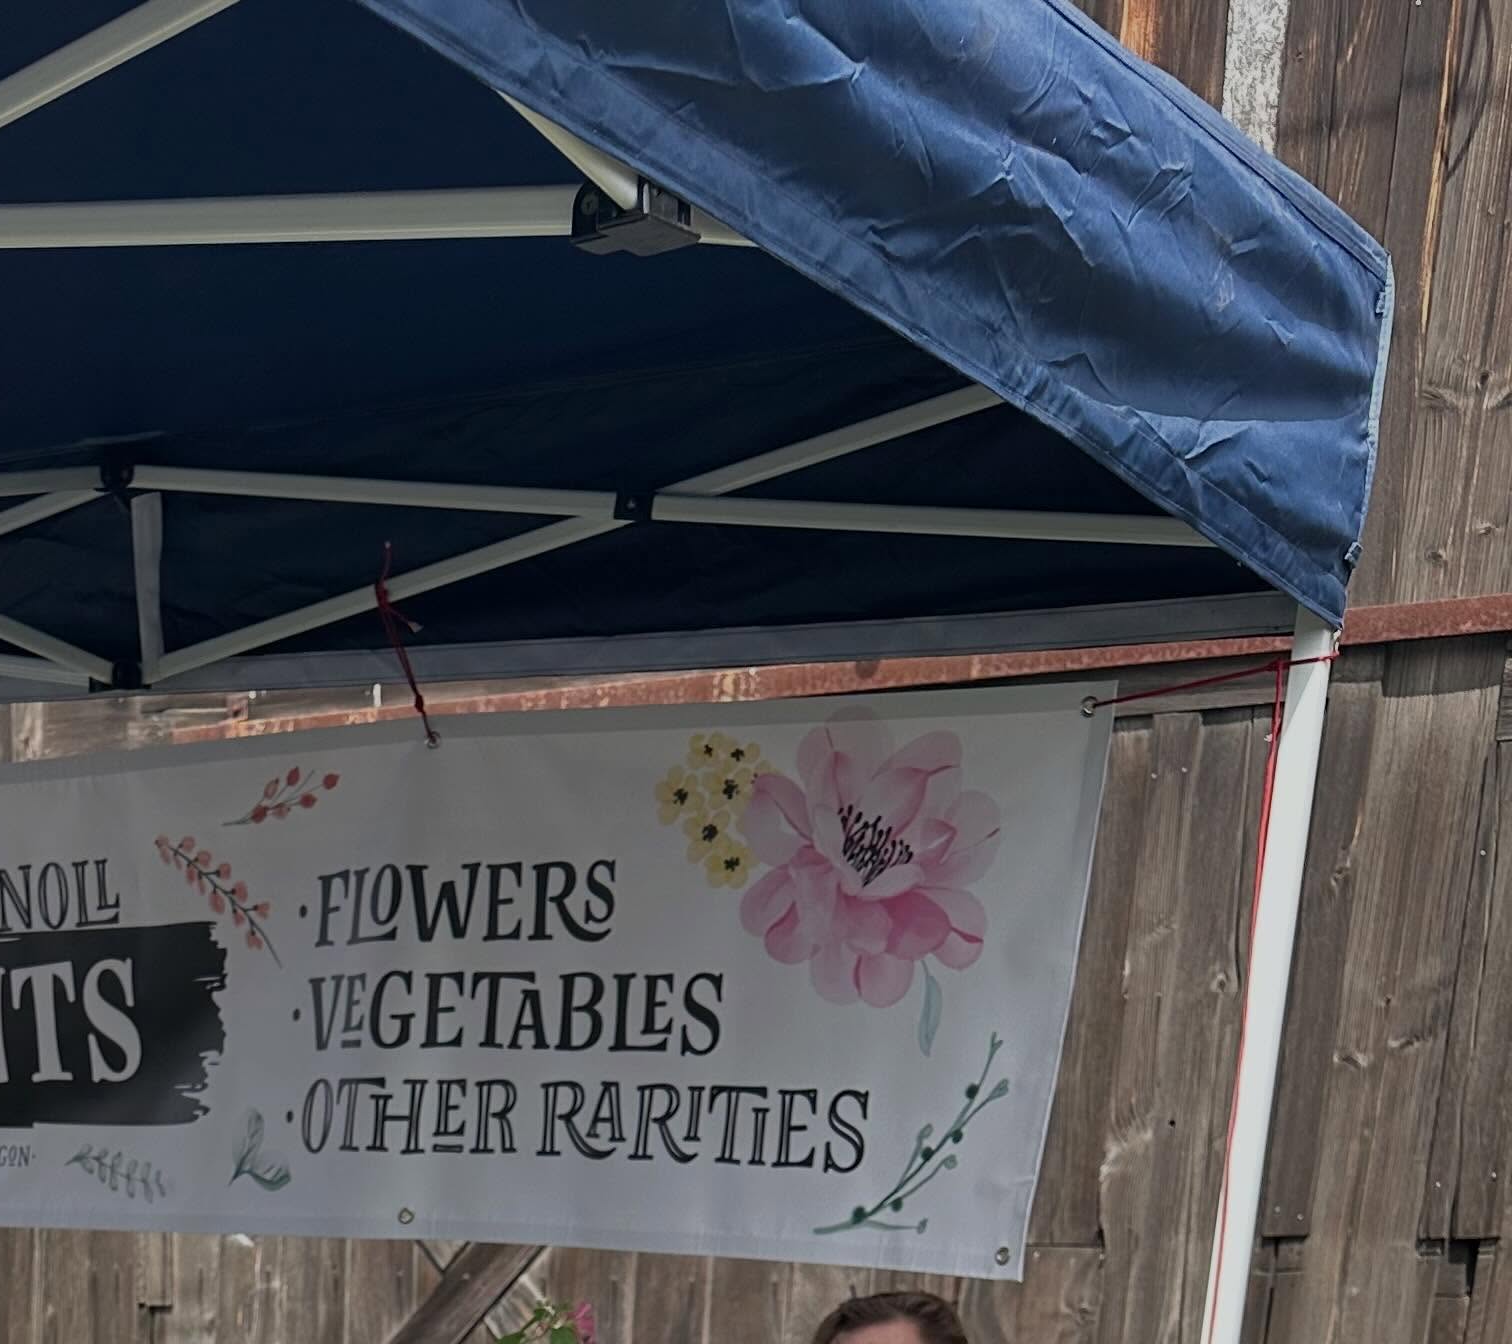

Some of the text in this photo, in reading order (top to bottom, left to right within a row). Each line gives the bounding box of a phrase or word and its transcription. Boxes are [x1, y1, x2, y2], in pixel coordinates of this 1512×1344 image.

[314, 858, 619, 948] FLOWERS
[308, 970, 724, 1056] VEGETABLES
[301, 1076, 870, 1174] OTHER RARITIES
